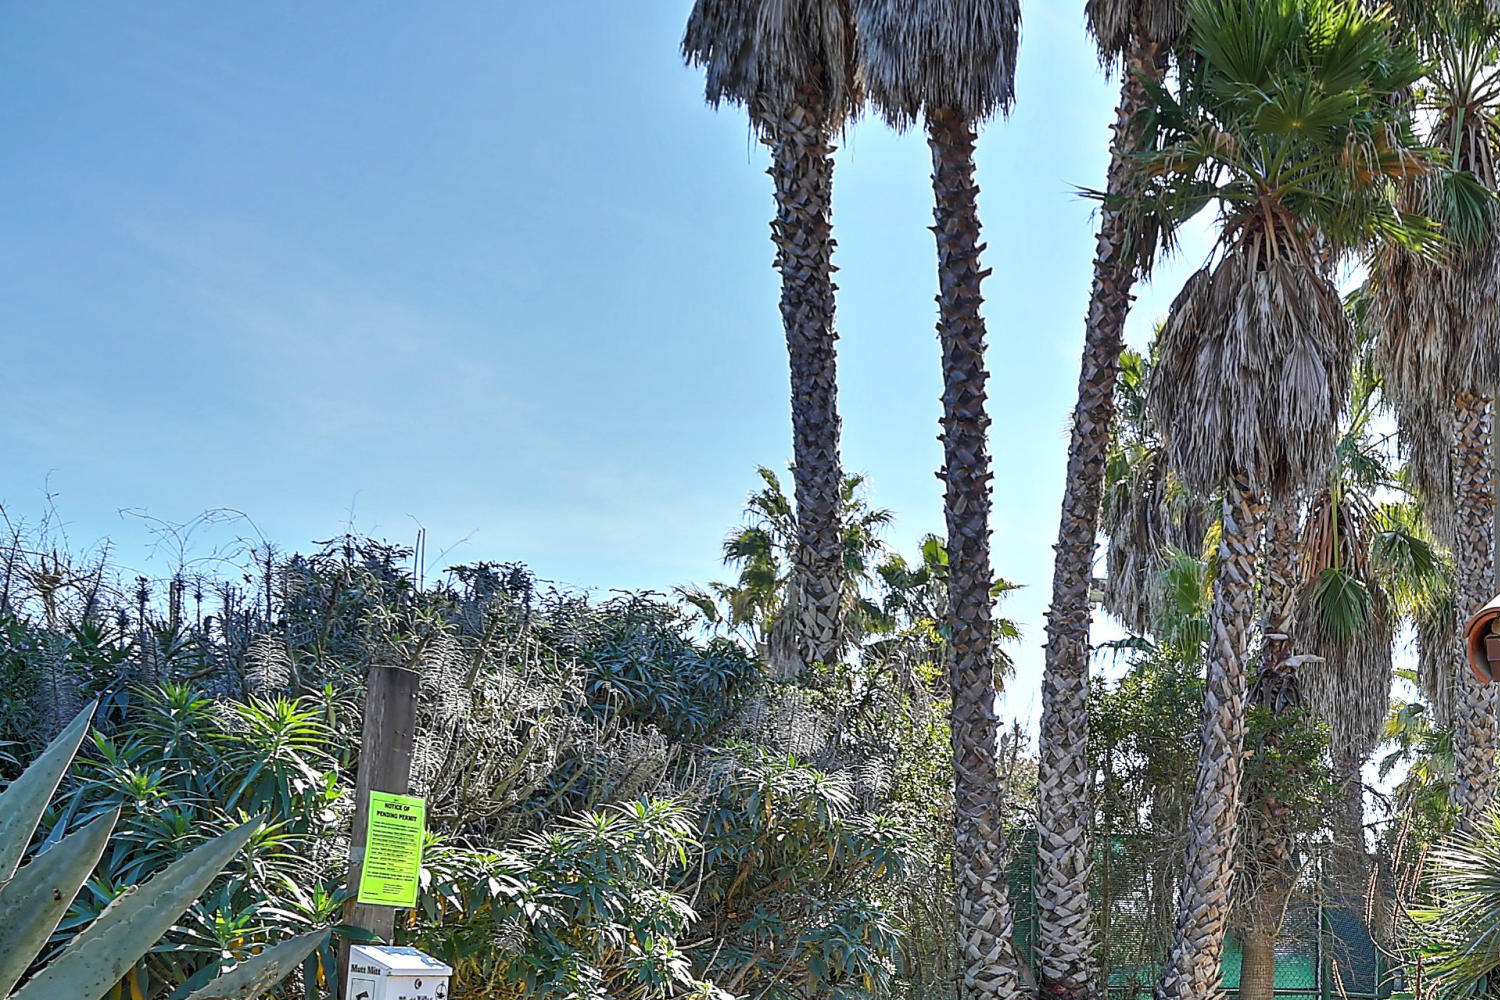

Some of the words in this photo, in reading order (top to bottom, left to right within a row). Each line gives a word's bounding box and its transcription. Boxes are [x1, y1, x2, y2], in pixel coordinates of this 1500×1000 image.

[384, 803, 402, 811] NOTICE
[376, 810, 398, 819] PENDING
[351, 964, 366, 974] Mutt
[367, 966, 381, 975] Mitt
